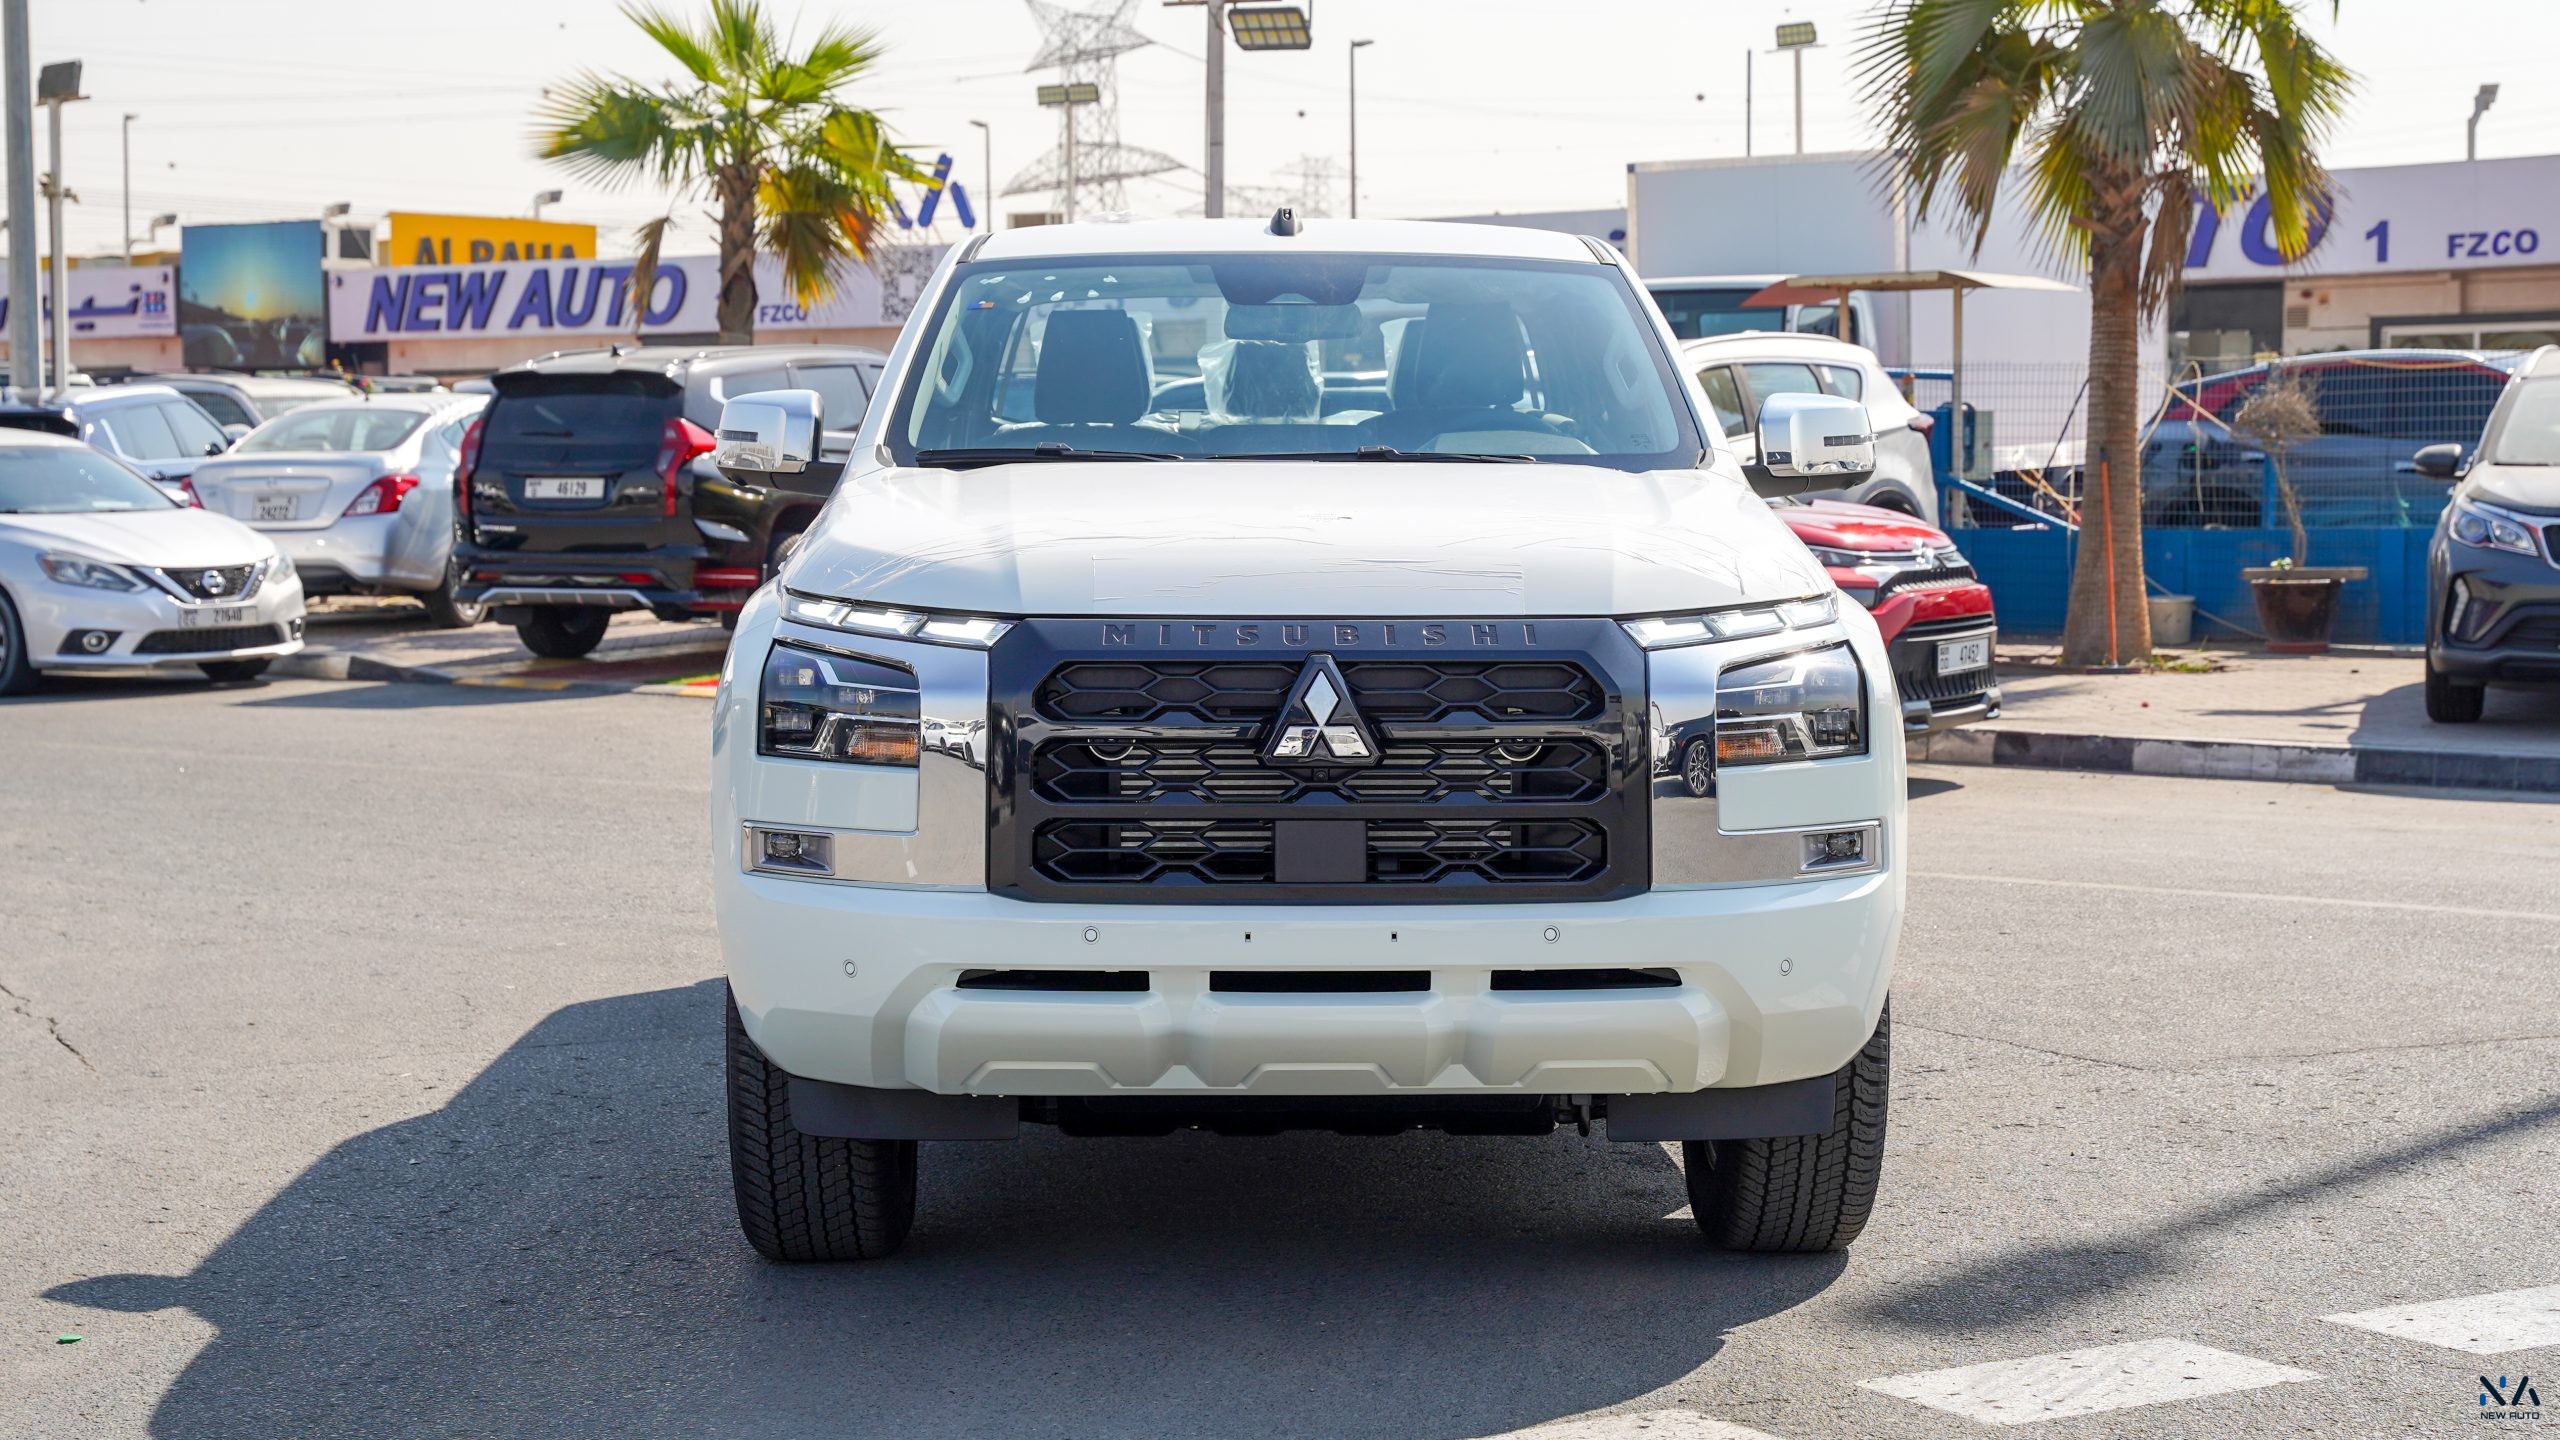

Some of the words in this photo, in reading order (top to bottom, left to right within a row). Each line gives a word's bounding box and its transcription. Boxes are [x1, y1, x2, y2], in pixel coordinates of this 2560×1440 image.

[2365, 220, 2390, 263] 1
[2447, 229, 2540, 259] FZCO
[364, 269, 506, 334] NEW
[507, 264, 688, 331] AUTO
[557, 482, 588, 495] 46129
[1102, 624, 1537, 646] MITSUBISHI
